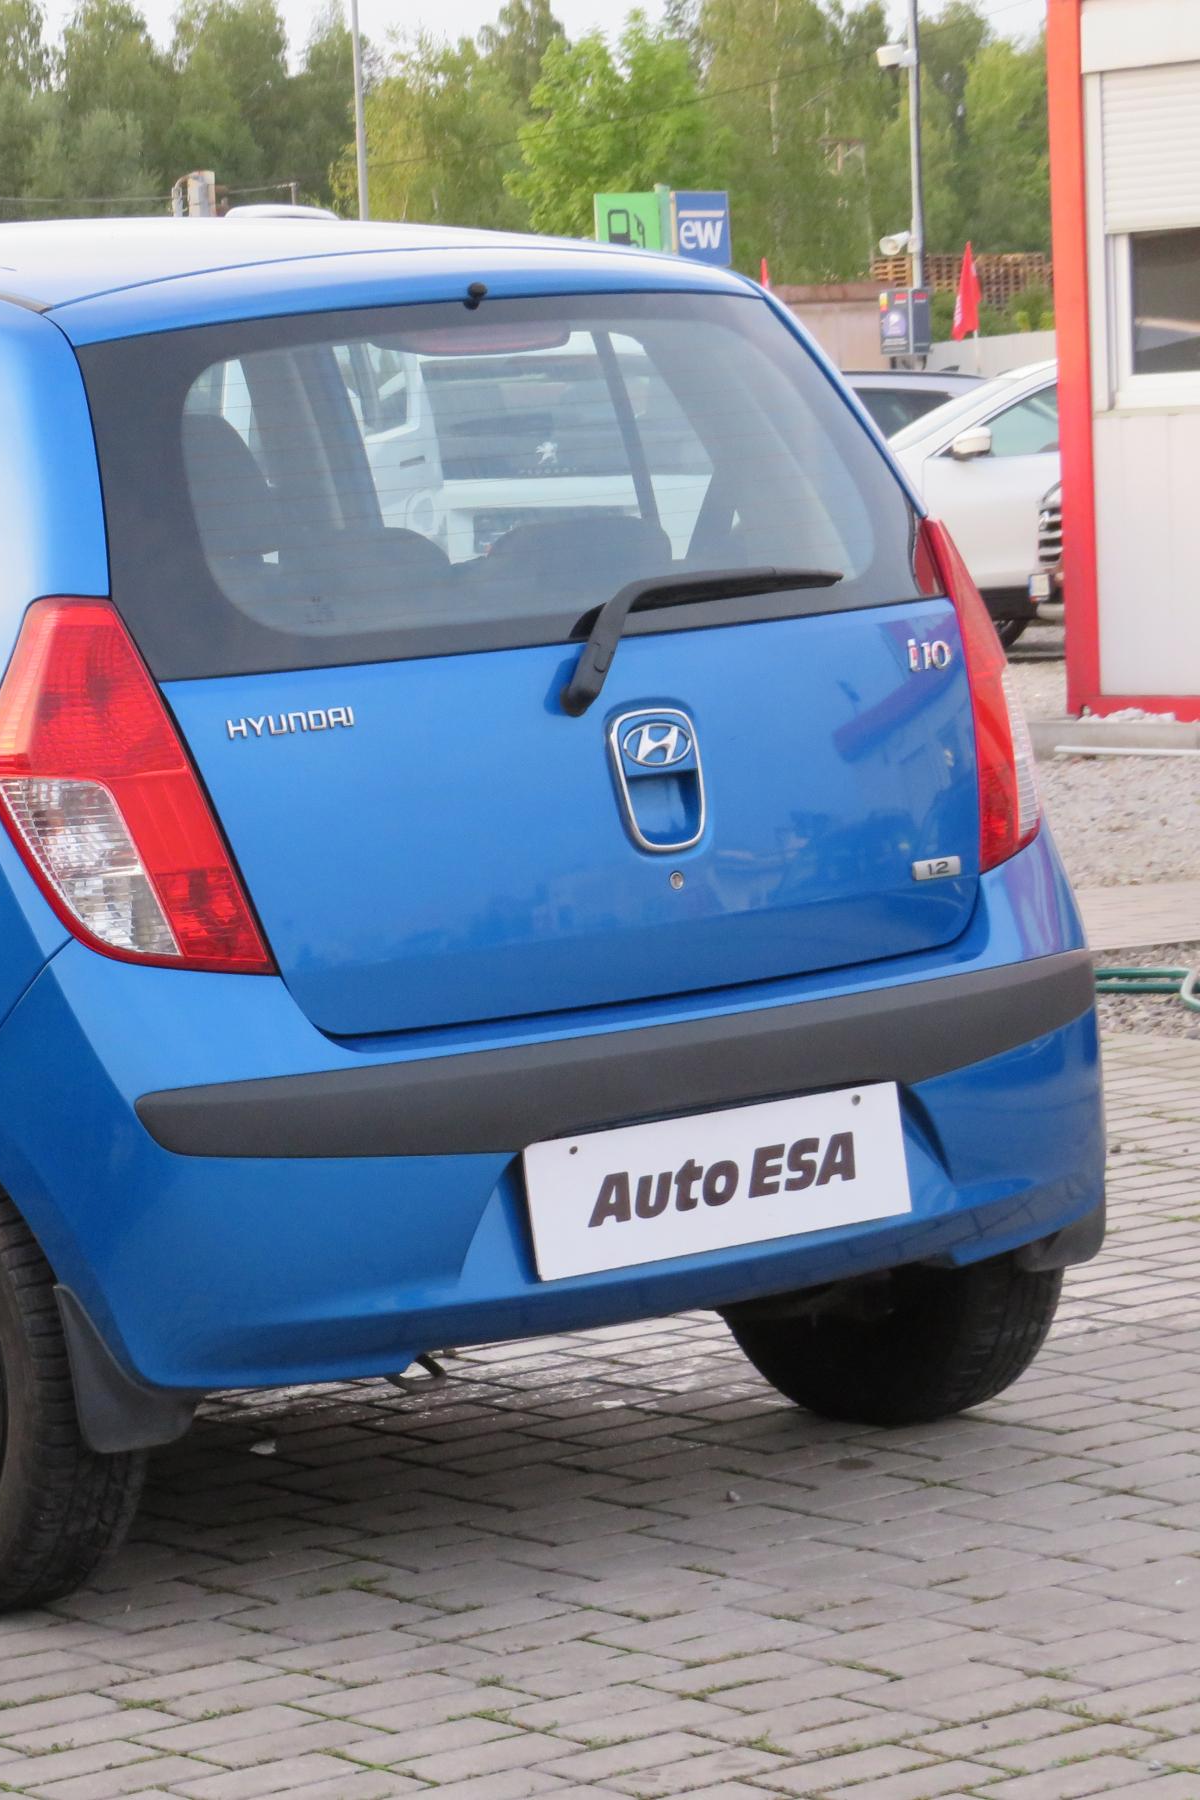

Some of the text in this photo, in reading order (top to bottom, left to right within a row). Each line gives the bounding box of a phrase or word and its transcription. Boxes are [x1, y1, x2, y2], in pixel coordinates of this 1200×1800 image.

[680, 220, 723, 250] ew
[907, 638, 953, 672] i10
[226, 705, 354, 740] HYUNDAI
[588, 1131, 856, 1227] Auto ESA
